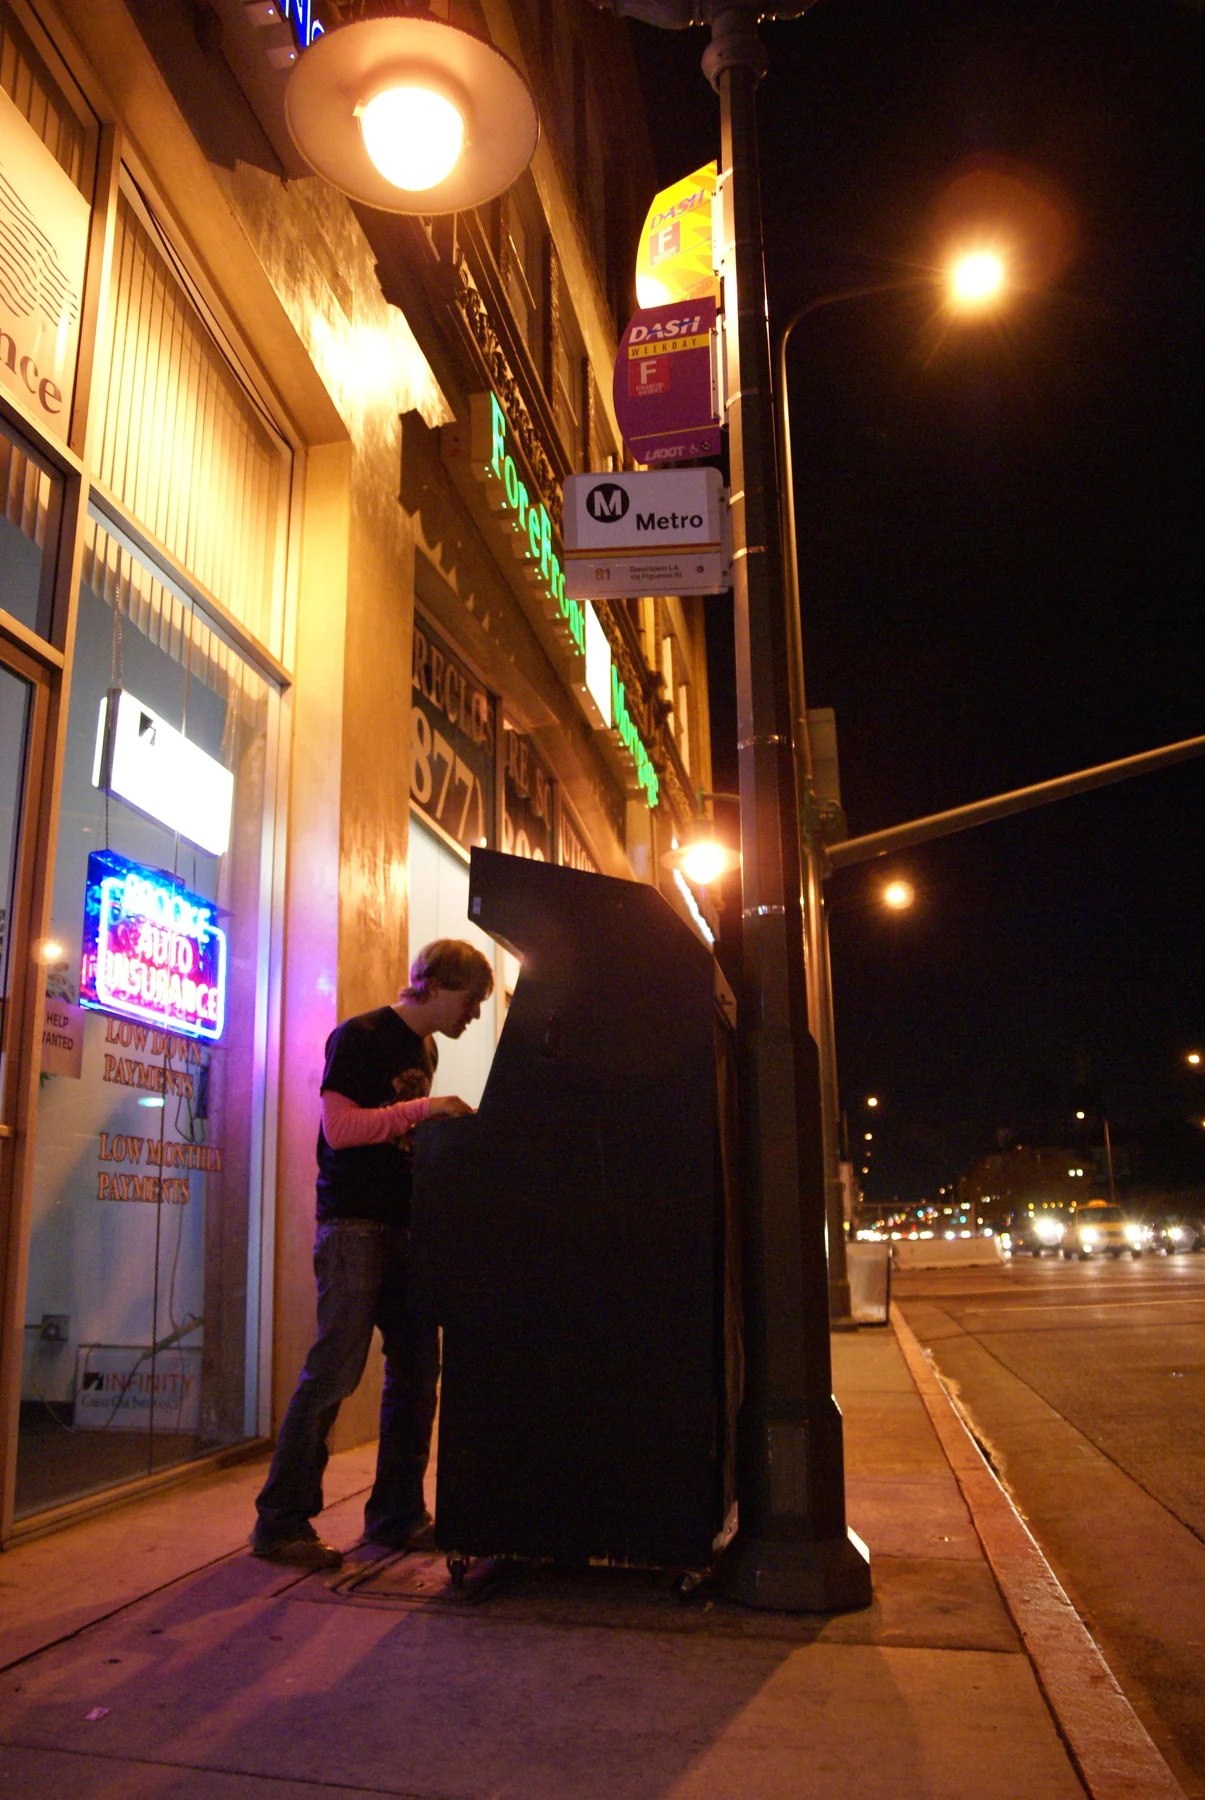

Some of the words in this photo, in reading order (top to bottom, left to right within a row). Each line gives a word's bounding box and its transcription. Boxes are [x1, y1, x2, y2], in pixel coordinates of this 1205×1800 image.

[650, 187, 705, 230] DASH
[629, 316, 700, 343] DASH
[632, 338, 697, 357] WEEKDAY
[640, 360, 657, 384] F
[644, 446, 685, 461] LADOT
[592, 487, 624, 519] M
[636, 513, 703, 531] Metro
[595, 568, 611, 581] 81
[137, 921, 194, 974] AUTO
[104, 950, 218, 1021] INSURANCE
[46, 1011, 70, 1029] HELP
[105, 1017, 149, 1051] LOW
[151, 1031, 202, 1066] DOWN
[102, 1053, 194, 1099] PAYMENTS
[99, 1132, 144, 1164] LOW
[146, 1137, 223, 1172] MONTHLY
[97, 1171, 191, 1205] PAYMENTS
[104, 1372, 195, 1393] INFINITY
